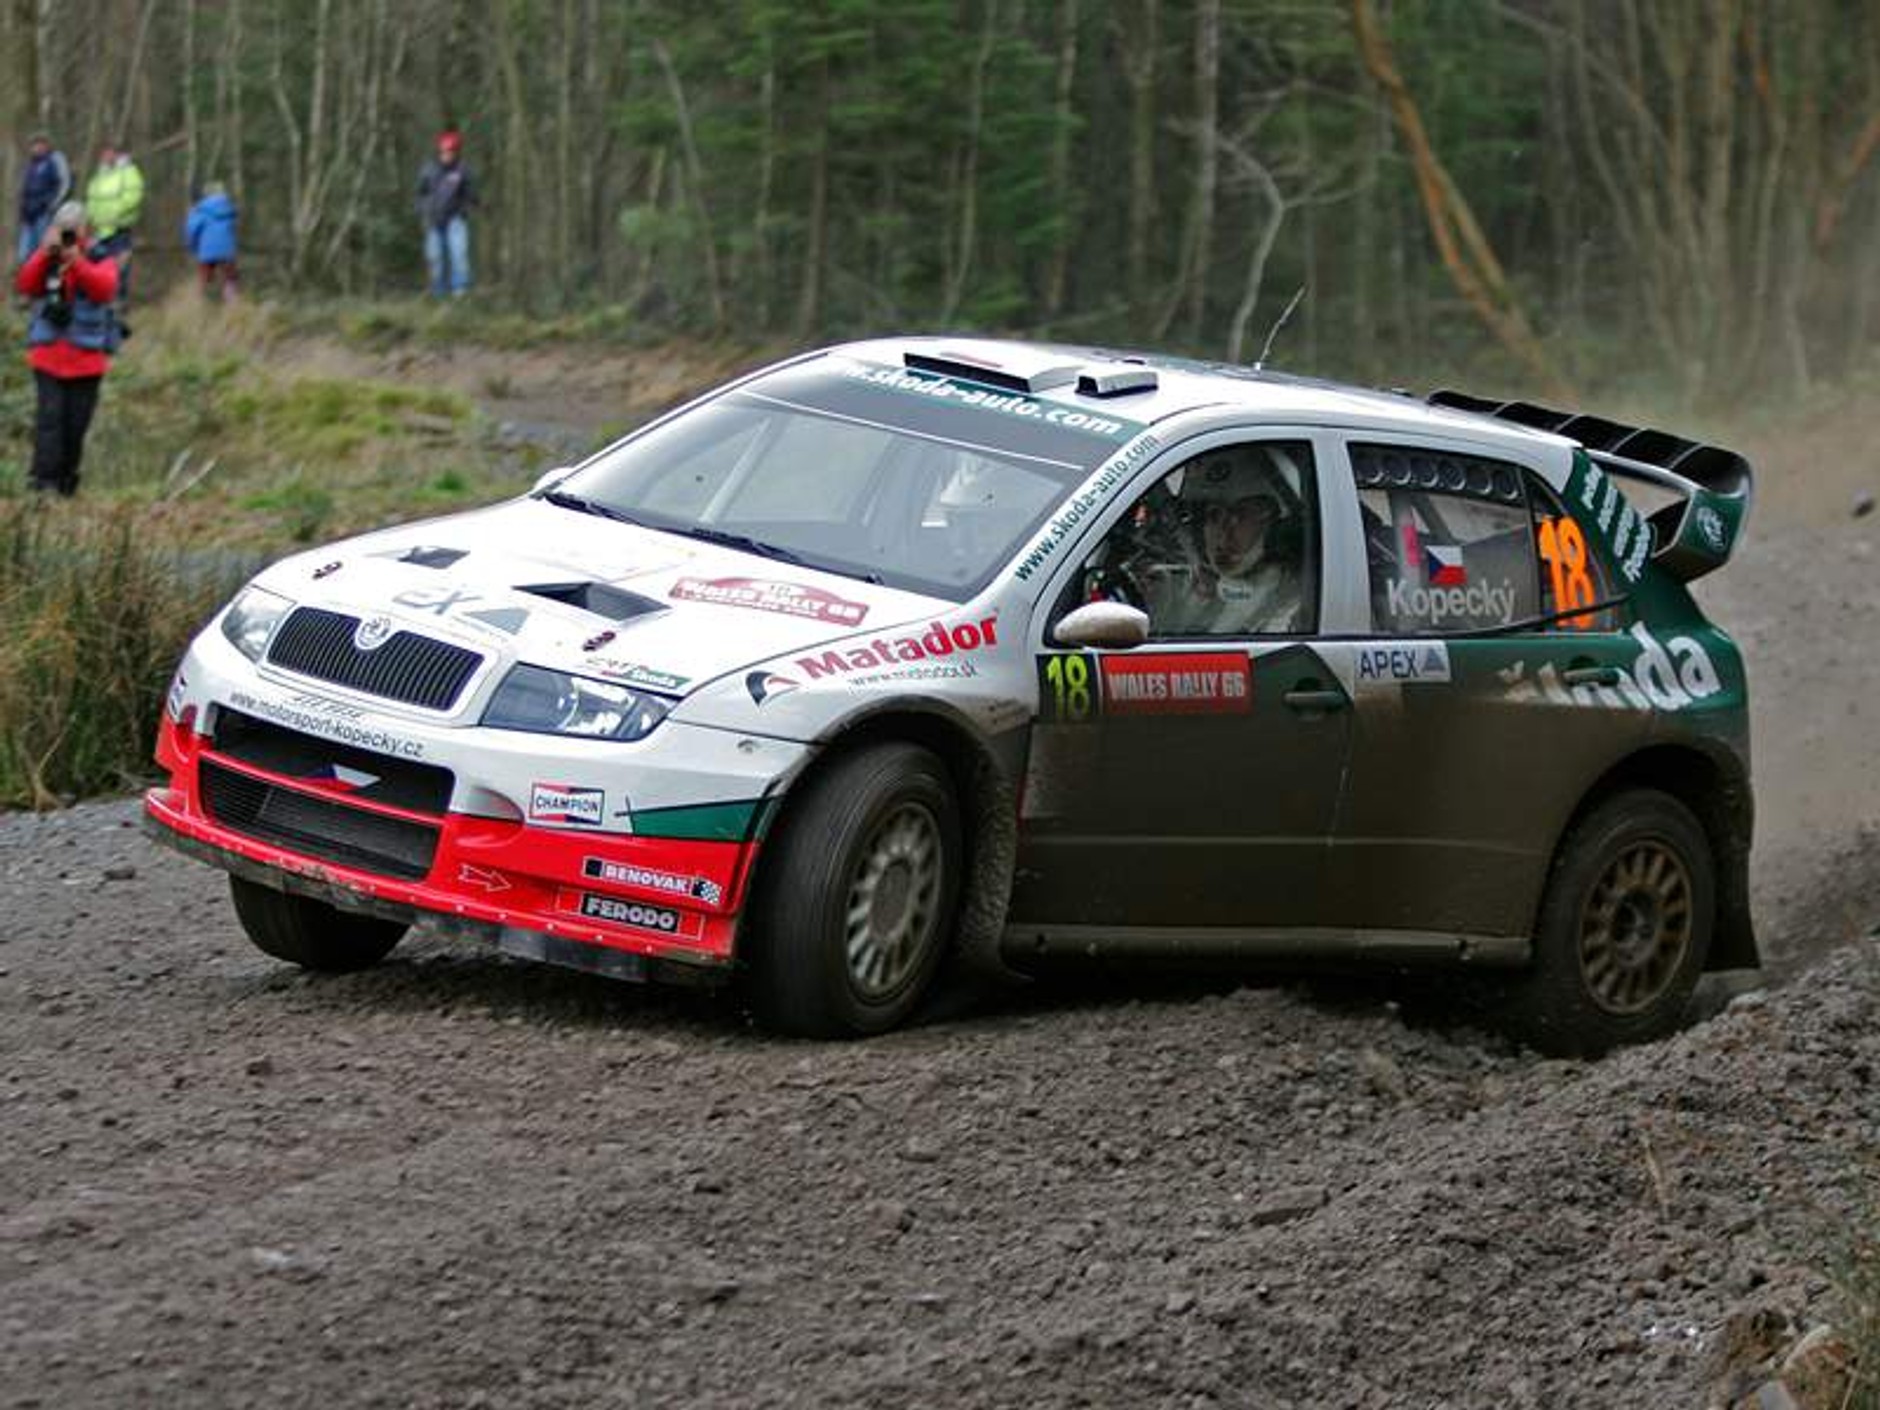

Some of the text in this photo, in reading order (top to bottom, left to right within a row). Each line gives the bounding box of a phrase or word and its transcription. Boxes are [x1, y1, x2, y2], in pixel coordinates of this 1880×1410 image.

[1014, 434, 1159, 582] www.skoda-auto.com
[1539, 514, 1596, 629] 18
[1386, 577, 1516, 624] Kopecký
[796, 615, 998, 681] Matador
[1360, 650, 1420, 678] APEX
[1046, 654, 1090, 720] 18
[1108, 672, 1168, 700] WALES
[1170, 671, 1218, 699] RALLY
[230, 692, 424, 757] www.motorsport-kopecky.cz
[536, 794, 599, 813] CHAMPION
[605, 863, 688, 892] RENOVAK
[586, 897, 675, 929] FERODO
